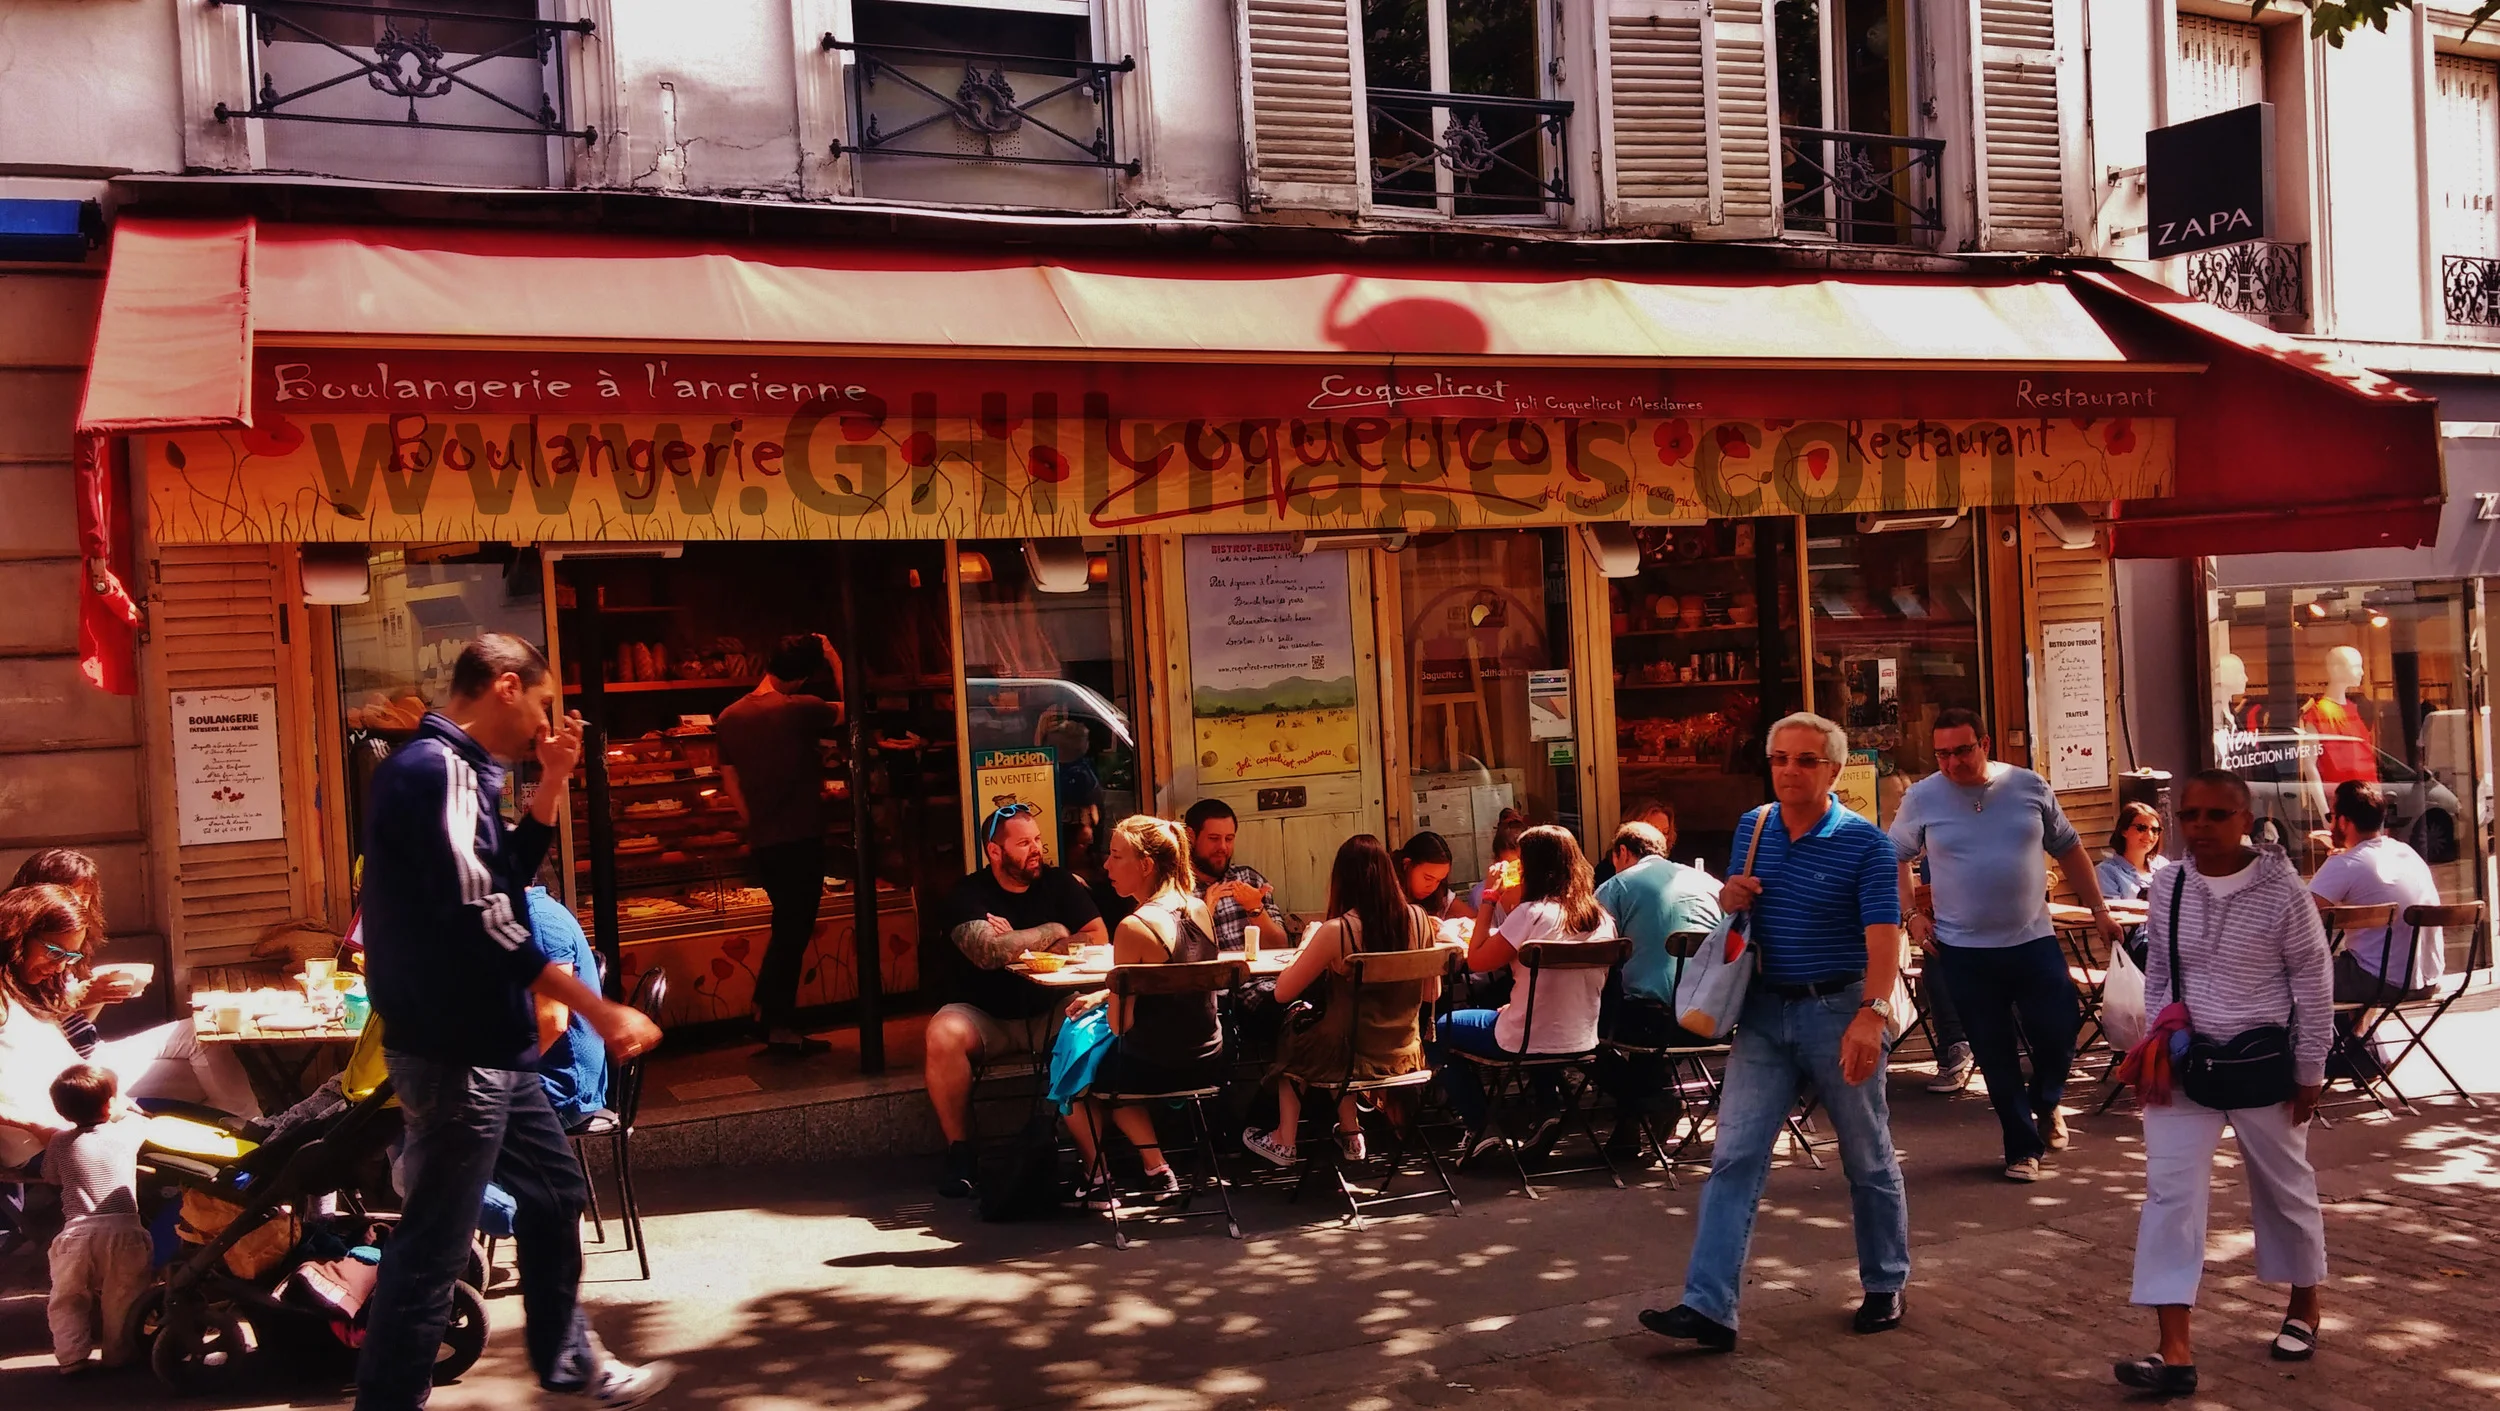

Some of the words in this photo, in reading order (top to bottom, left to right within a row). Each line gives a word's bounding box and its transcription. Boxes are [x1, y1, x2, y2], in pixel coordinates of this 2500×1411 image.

[2158, 208, 2252, 246] ZAPA
[274, 363, 570, 411] Boulangerie
[596, 368, 621, 398] à
[644, 361, 867, 401] l'ancienne
[1307, 372, 1509, 410] Coquelicot
[2015, 379, 2158, 409] Restaurant
[1513, 395, 1538, 414] joli
[1545, 396, 1623, 413] Coquelicot
[1629, 396, 1703, 411] Mesdames
[1846, 418, 2056, 464] Restaurant
[388, 412, 786, 500] Boulangerie
[1480, 668, 1507, 678] adition
[189, 713, 259, 725] BOULANGERIE
[2065, 710, 2089, 718] TRAITEUR
[994, 751, 1050, 767] Parisien
[2224, 749, 2283, 769] COLLECTION
[2284, 745, 2311, 760] HIVER
[2313, 744, 2325, 756] 15
[984, 776, 998, 786] EN
[1000, 774, 1032, 785] VENTE
[1034, 771, 1046, 782] ICI
[1270, 791, 1292, 806] 24
